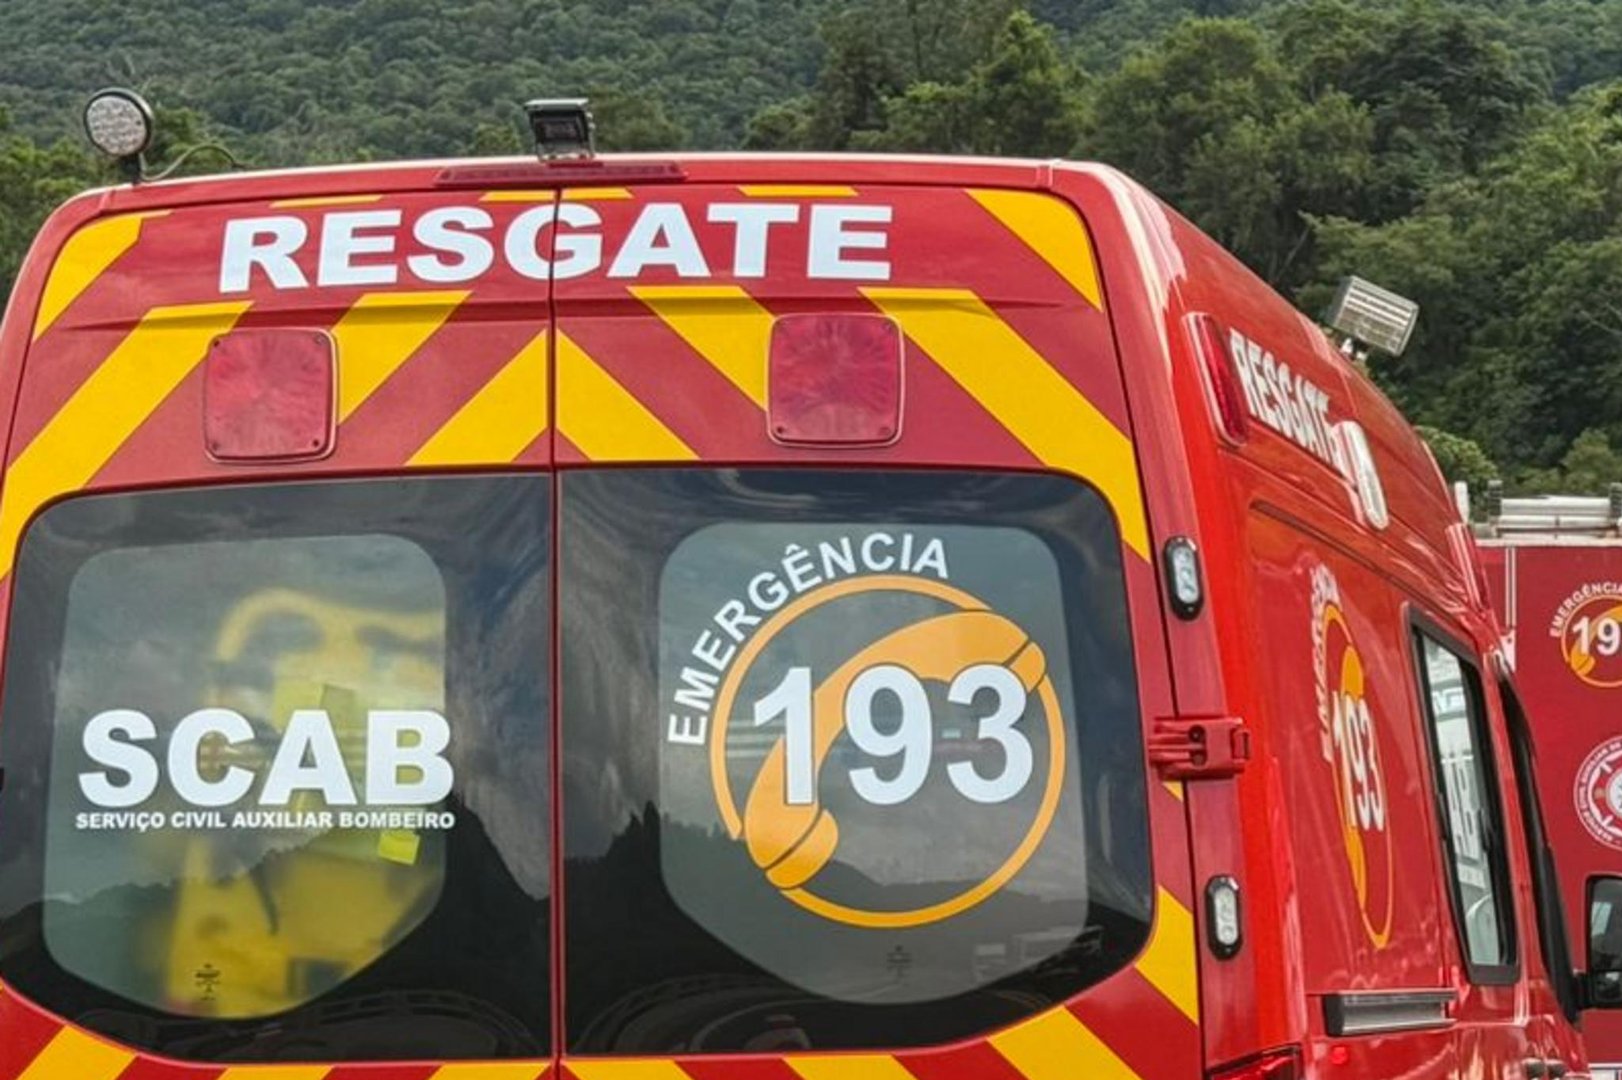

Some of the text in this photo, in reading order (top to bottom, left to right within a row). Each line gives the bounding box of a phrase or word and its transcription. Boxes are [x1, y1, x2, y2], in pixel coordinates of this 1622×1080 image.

[219, 202, 893, 294] RESGATE
[667, 532, 950, 746] EMERGÊNCIA
[78, 708, 455, 807] SCAB
[753, 661, 1034, 806] 193
[1332, 689, 1385, 832] 193
[75, 811, 456, 833] SERVIÇO CIVIL AUXILIAR BOMBEIRO
